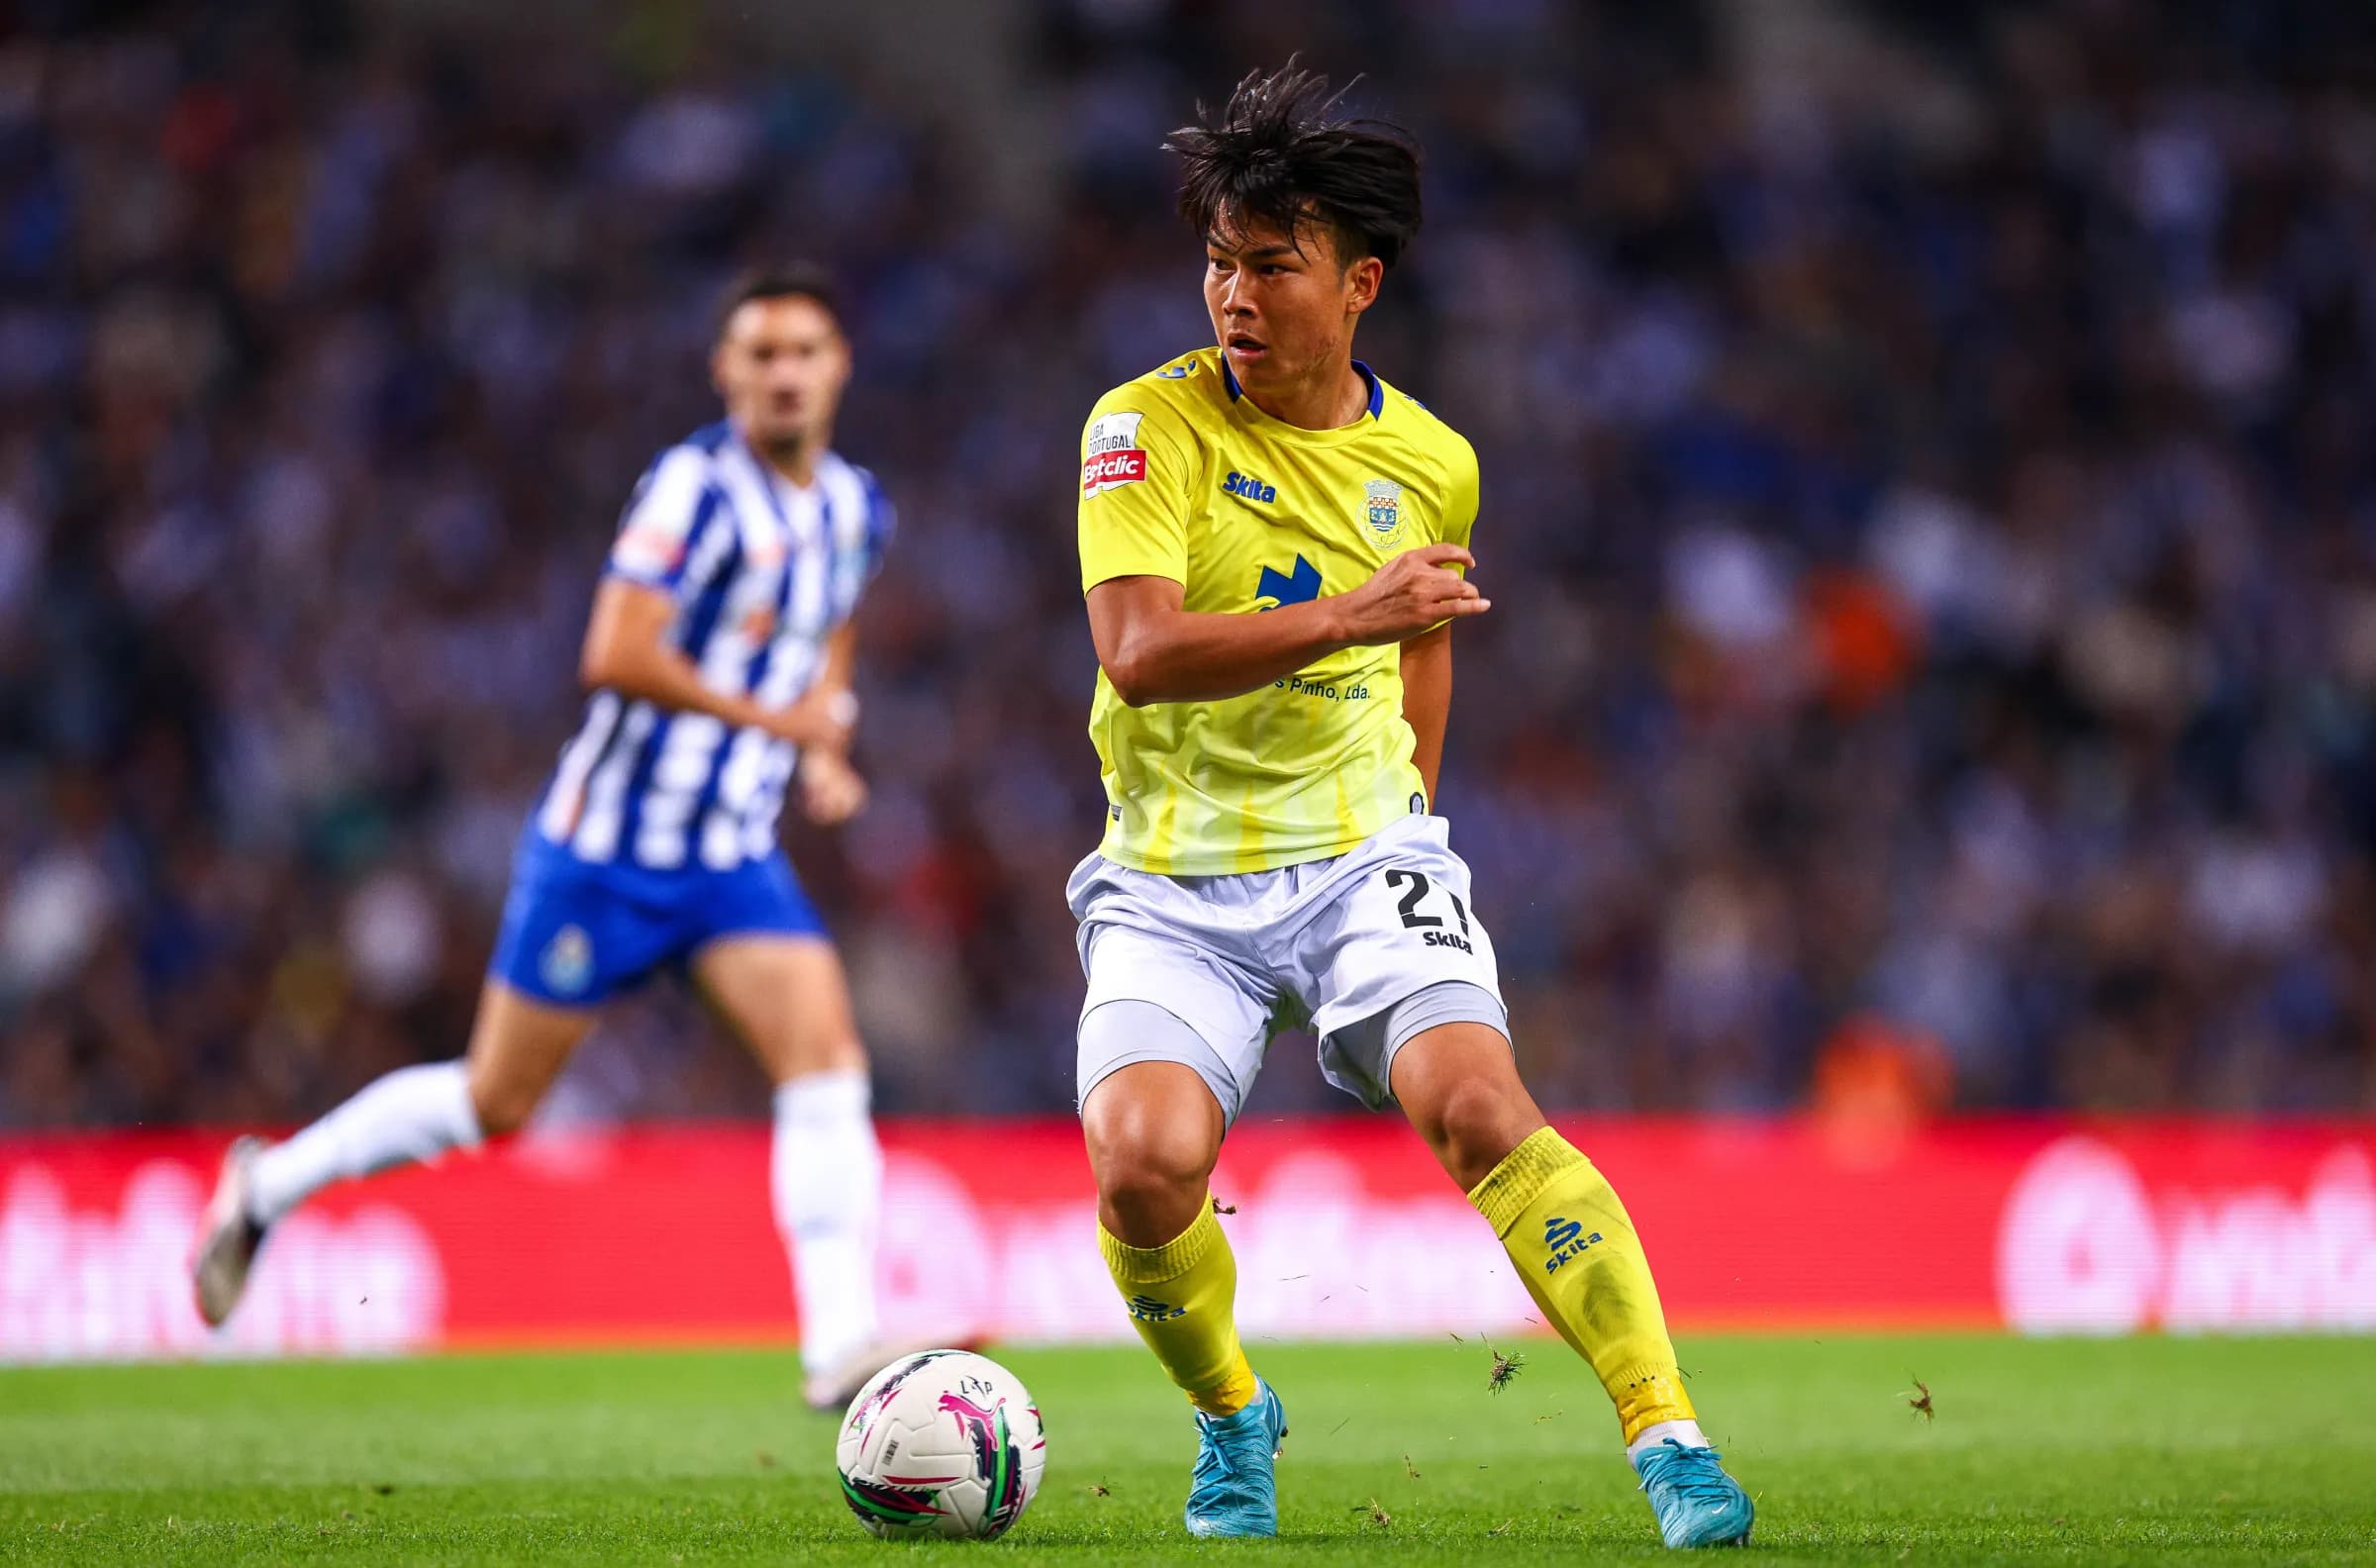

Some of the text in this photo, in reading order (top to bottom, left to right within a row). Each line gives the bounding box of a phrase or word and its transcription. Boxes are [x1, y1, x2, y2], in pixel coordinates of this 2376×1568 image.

[1222, 471, 1276, 504] Skita
[1289, 677, 1340, 702] Pinho,
[1344, 684, 1371, 700] Lda.
[1422, 931, 1474, 956] Skita
